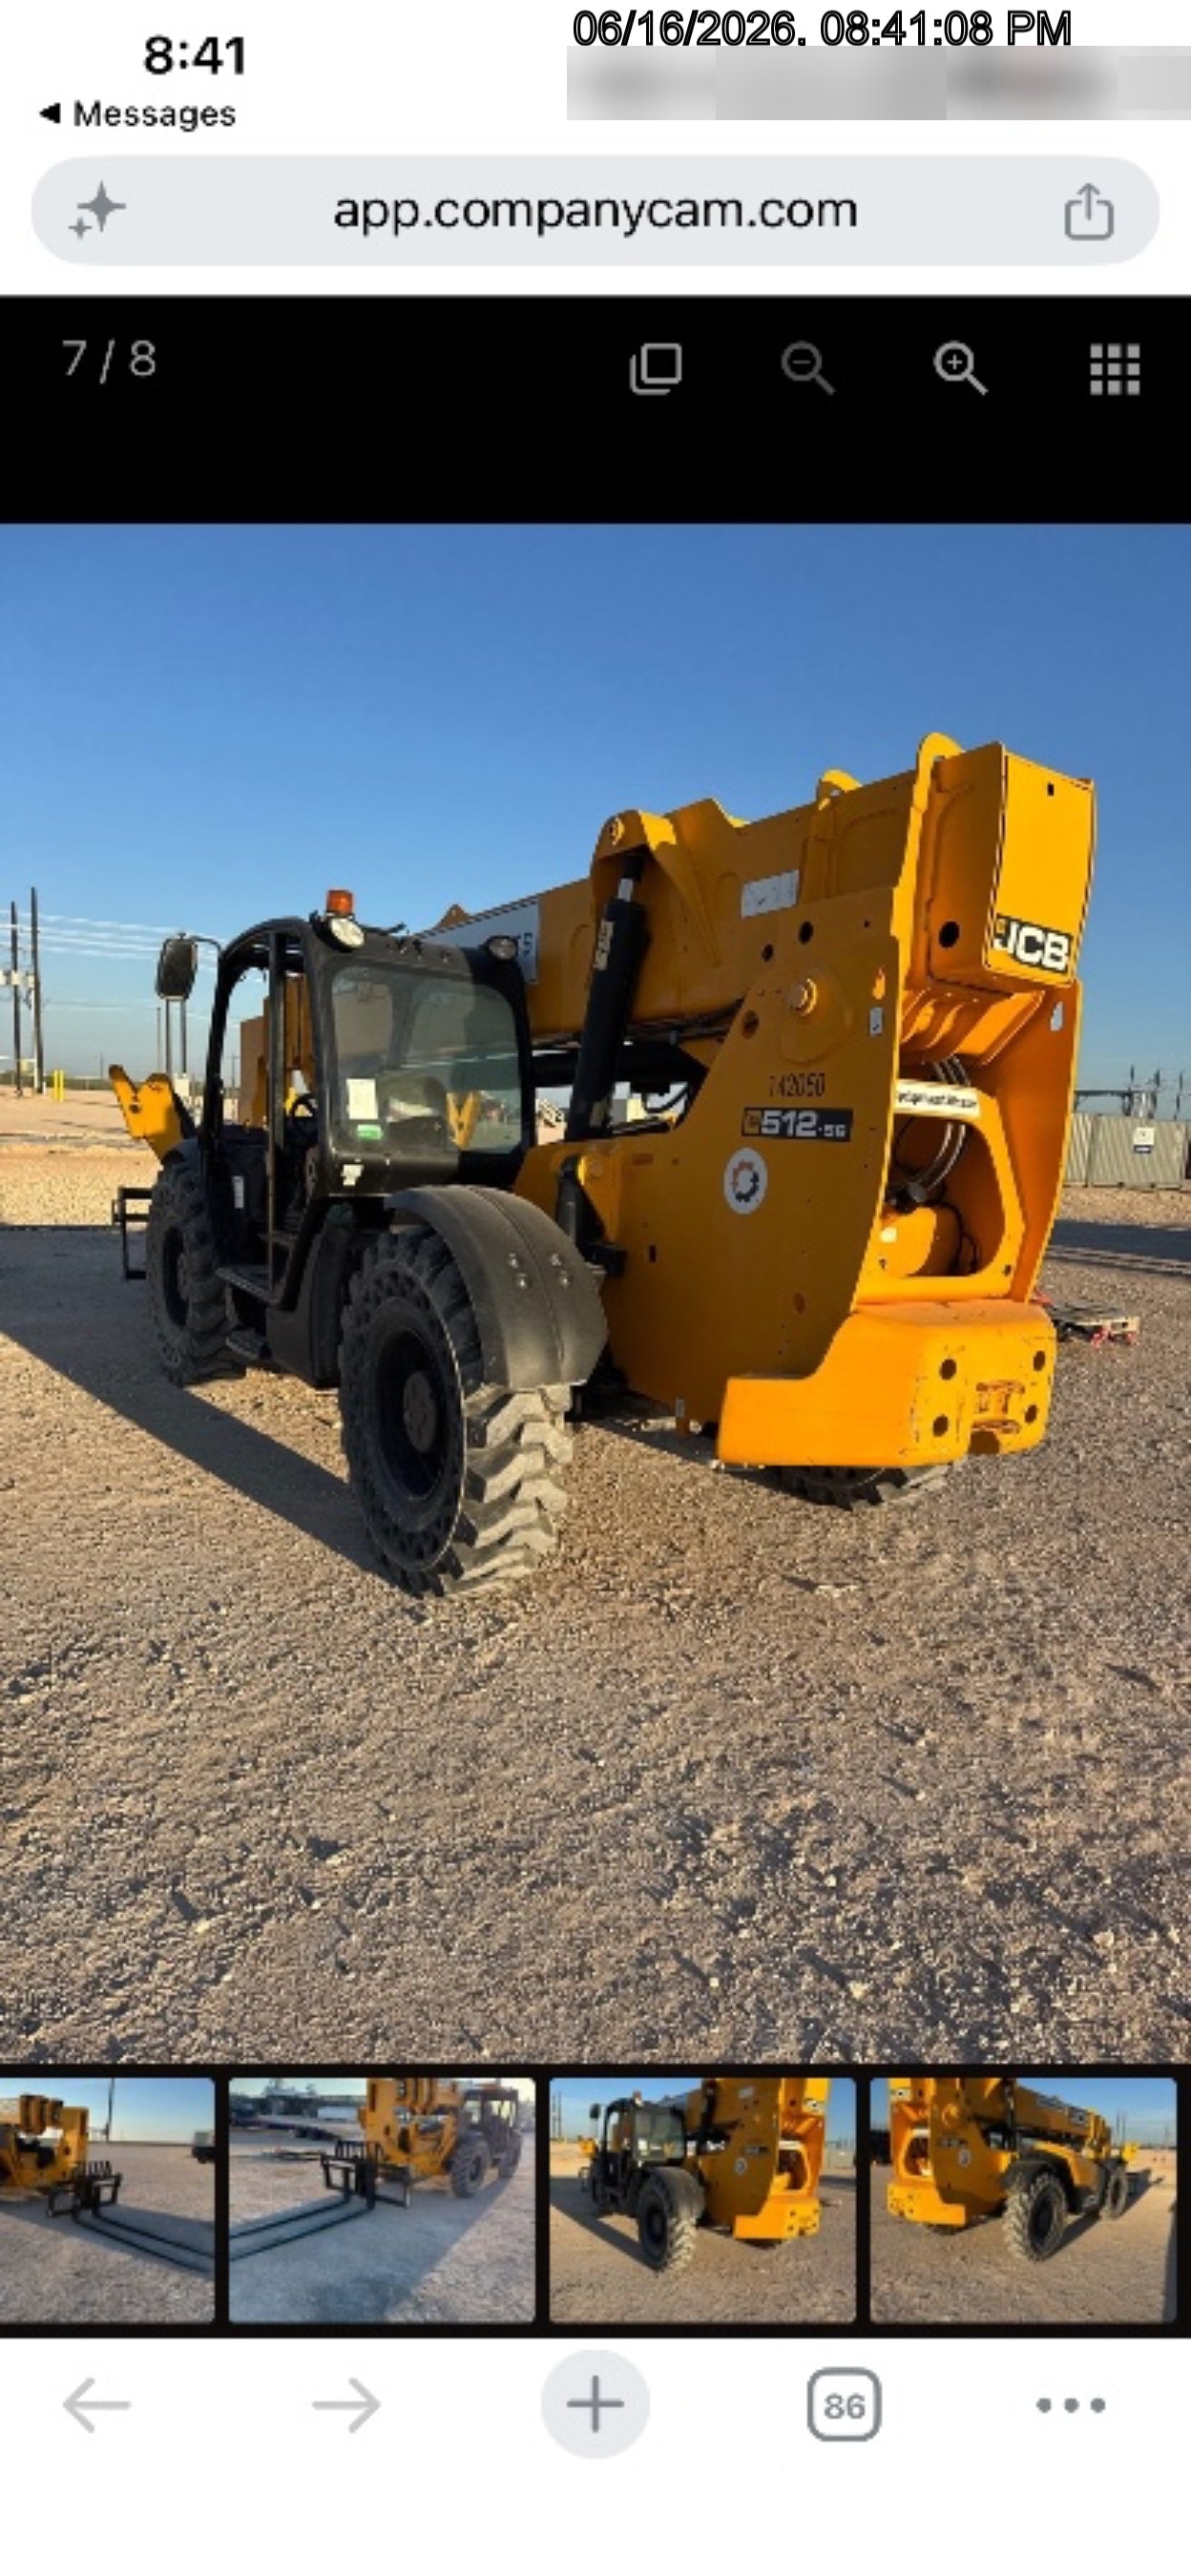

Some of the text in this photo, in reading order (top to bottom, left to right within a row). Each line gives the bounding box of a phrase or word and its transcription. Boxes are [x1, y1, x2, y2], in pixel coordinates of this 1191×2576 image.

[144, 35, 245, 75] 8:41
[73, 100, 237, 133] Messages
[334, 194, 858, 238] app.companycam.com
[62, 340, 87, 377] 7
[130, 340, 156, 377] 8
[993, 921, 1070, 971] JCB
[824, 2393, 867, 2420] 86
